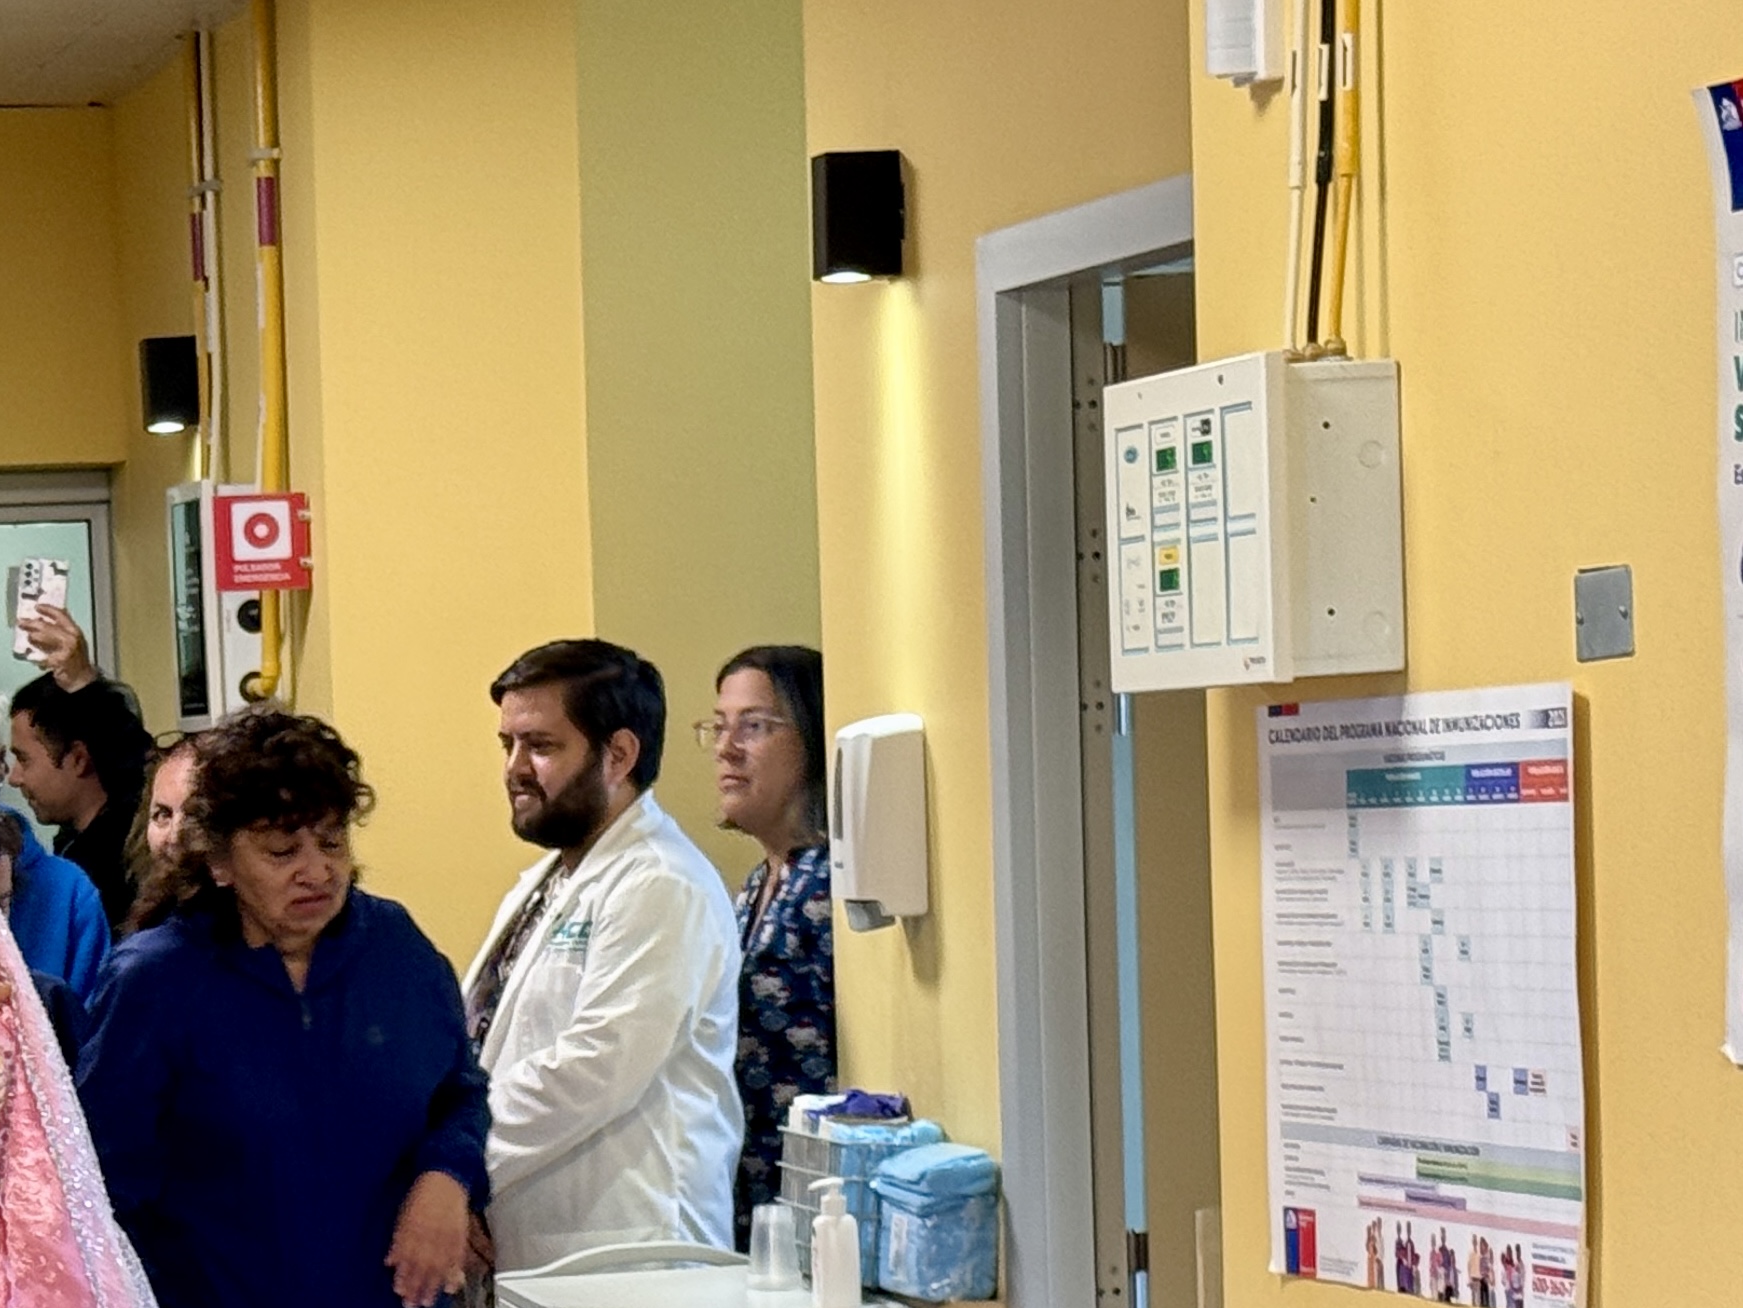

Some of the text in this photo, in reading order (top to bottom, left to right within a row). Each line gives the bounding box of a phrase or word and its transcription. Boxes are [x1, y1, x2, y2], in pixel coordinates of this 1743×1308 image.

[1268, 726, 1321, 745] CALENDARIO
[1322, 724, 1339, 741] DEL
[1384, 719, 1428, 737] NACIONAL
[1429, 718, 1441, 734] DE
